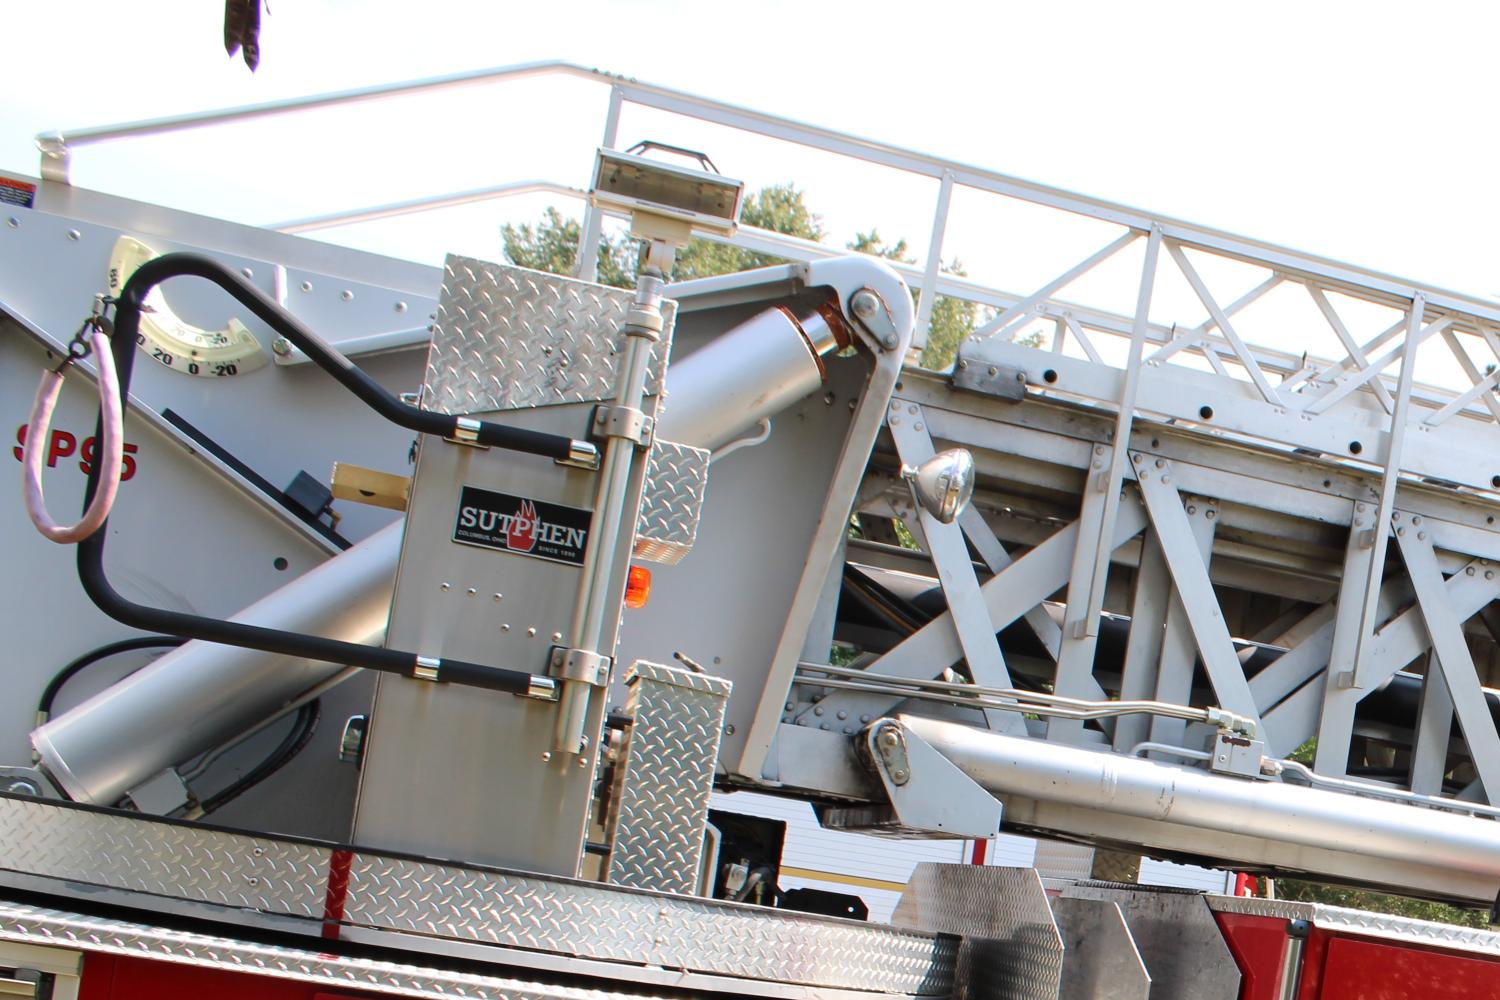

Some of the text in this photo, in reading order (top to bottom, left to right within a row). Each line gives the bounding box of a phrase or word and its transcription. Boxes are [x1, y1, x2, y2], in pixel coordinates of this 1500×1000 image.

[153, 348, 173, 365] 20
[188, 363, 199, 375] 0
[210, 363, 238, 377] -20
[460, 506, 587, 550] SUTPHEN
